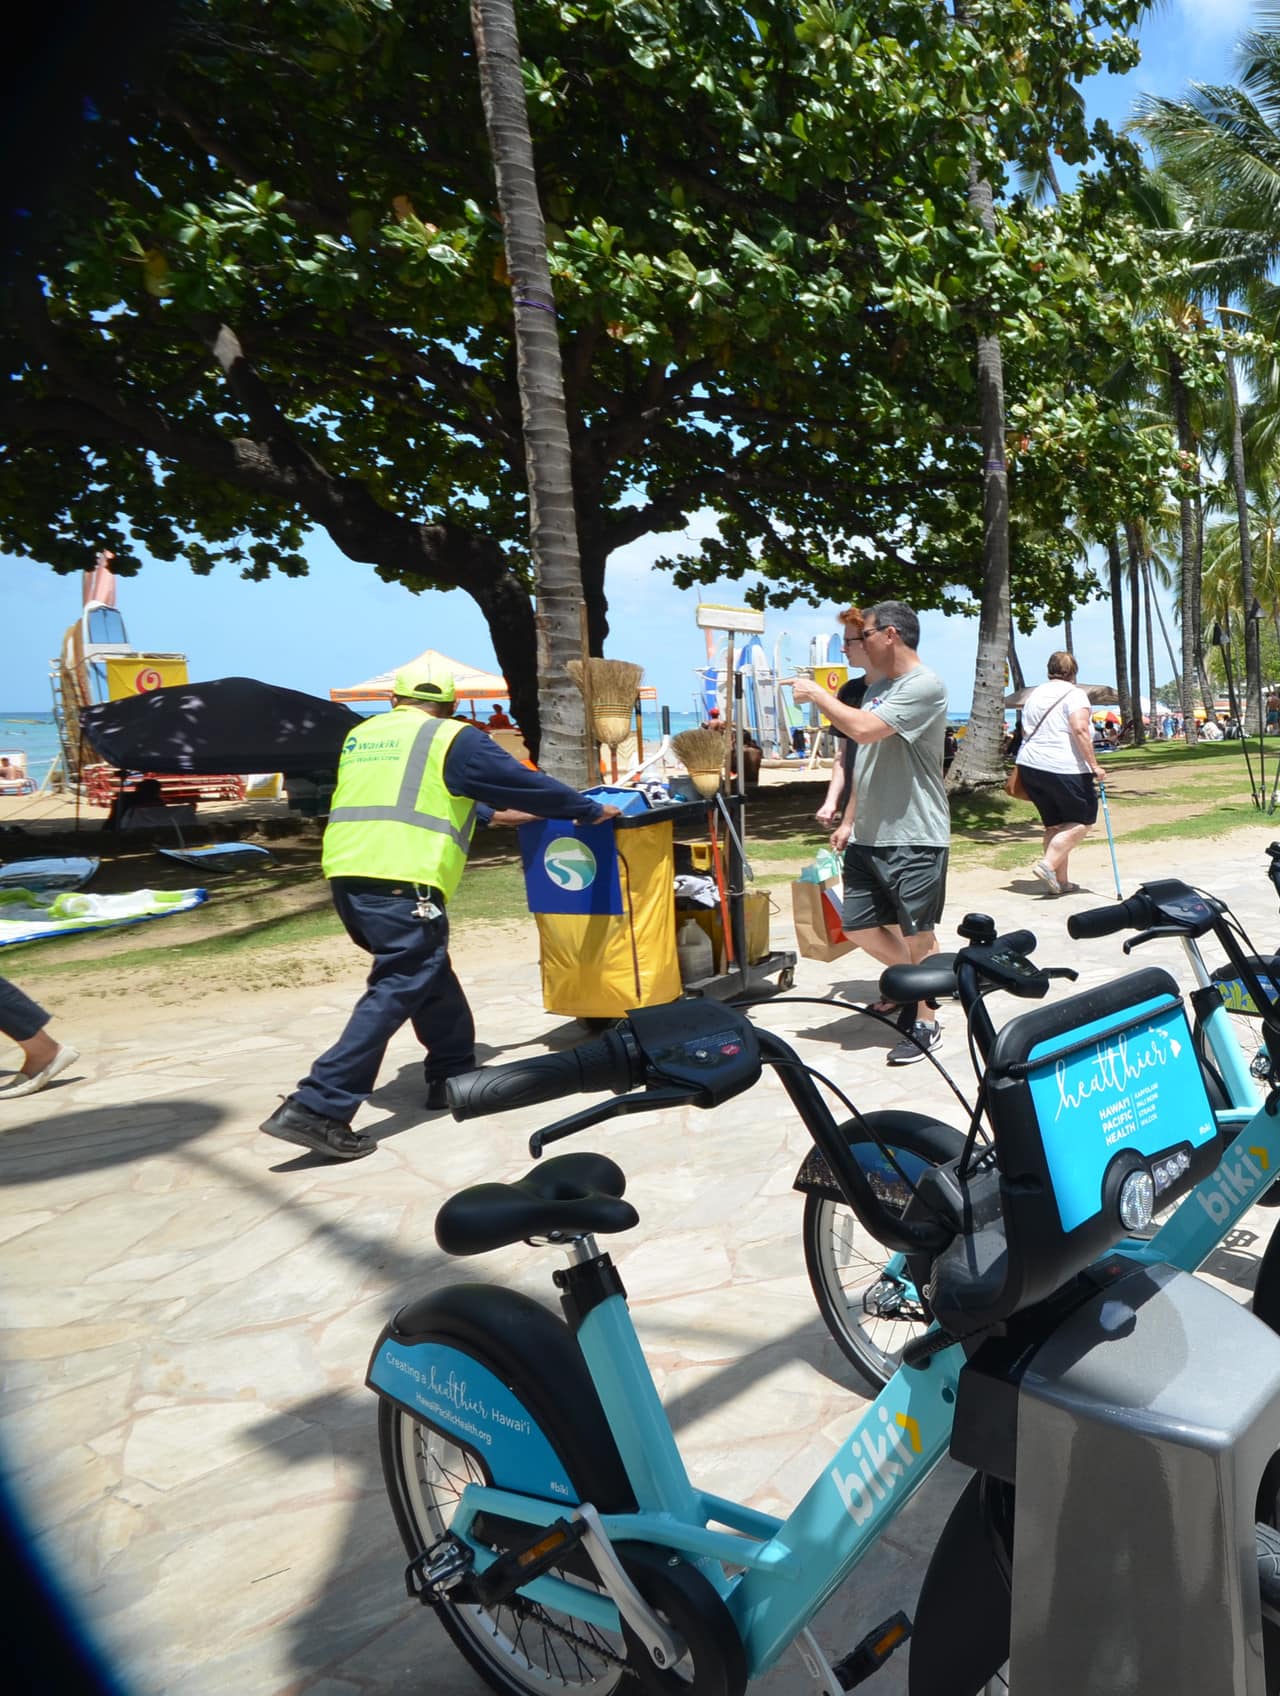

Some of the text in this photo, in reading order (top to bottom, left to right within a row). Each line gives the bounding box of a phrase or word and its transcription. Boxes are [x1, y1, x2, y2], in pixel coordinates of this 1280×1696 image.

[1055, 1033, 1167, 1121] healthier
[1102, 1109, 1133, 1133] PACIFIC
[1105, 1121, 1136, 1146] HEALTH
[1196, 1145, 1263, 1226] biki
[385, 1352, 420, 1384] Creating
[427, 1365, 488, 1418] healthier
[831, 1406, 914, 1527] biki
